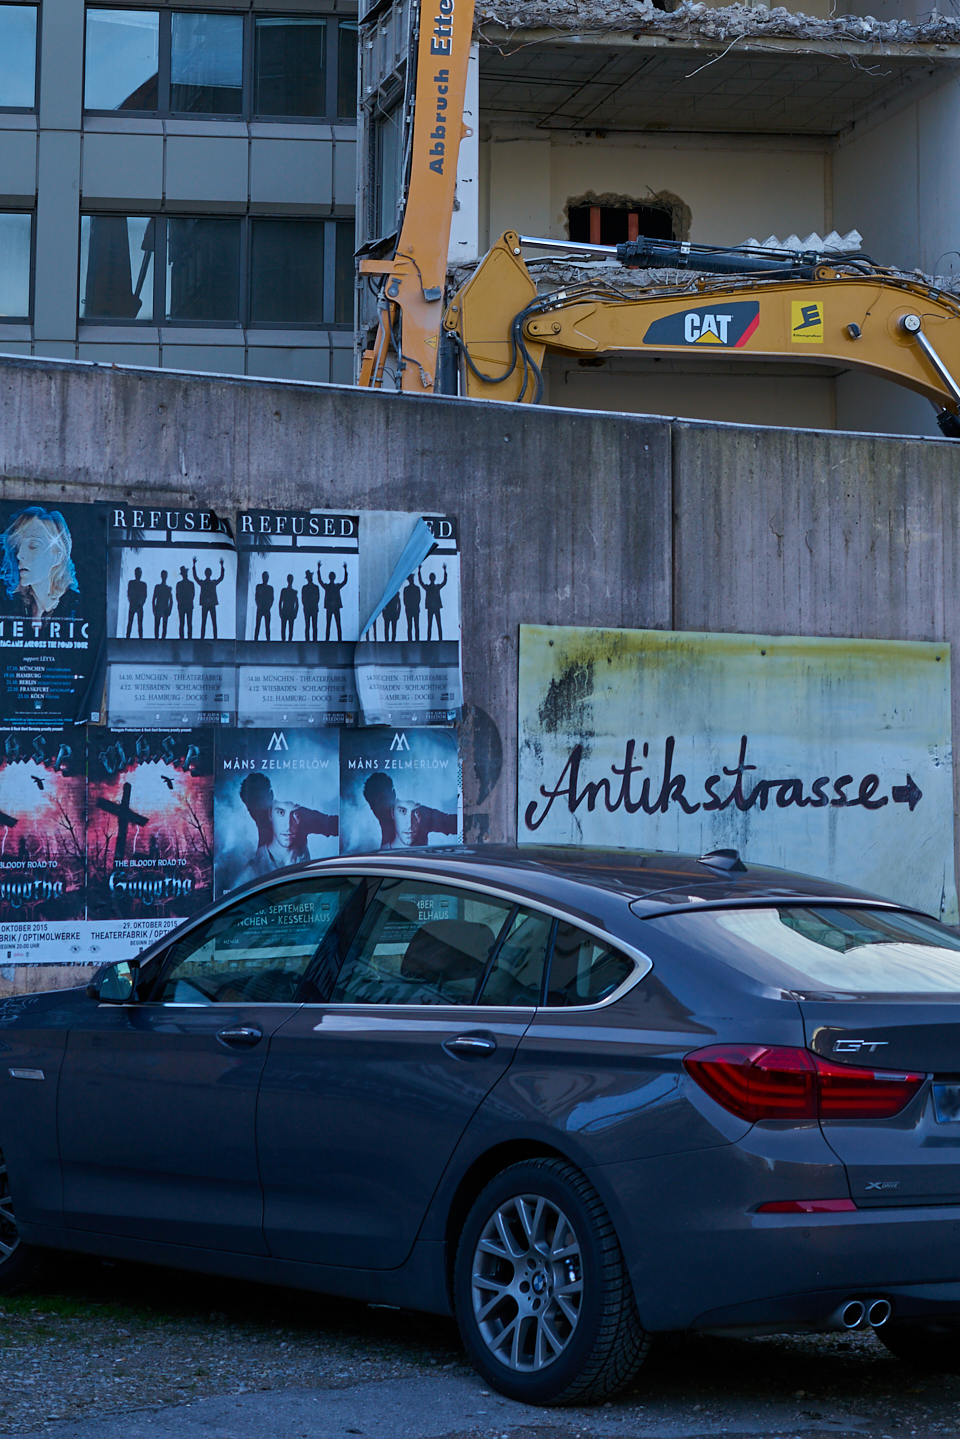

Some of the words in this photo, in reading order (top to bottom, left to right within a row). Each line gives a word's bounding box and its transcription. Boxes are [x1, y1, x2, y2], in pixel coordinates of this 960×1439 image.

[429, 69, 449, 175] Abbruch
[684, 313, 733, 344] CAT
[241, 515, 354, 536] REFUSED
[223, 757, 256, 770] MÅNS
[261, 758, 330, 770] ZELMERLÖW
[348, 757, 379, 769] MÅNS
[385, 758, 449, 769] ZELMERLÖW
[525, 735, 889, 830] Antikstrasse
[269, 902, 315, 915] SEPTEMBER
[133, 921, 162, 929] OKTOBER
[163, 920, 177, 928] 2015
[278, 913, 331, 925] KESSELHAUS
[23, 932, 80, 942] OPTIMOLWERKE
[91, 931, 147, 940] THEATERFABRIK
[832, 1039, 889, 1052] GT
